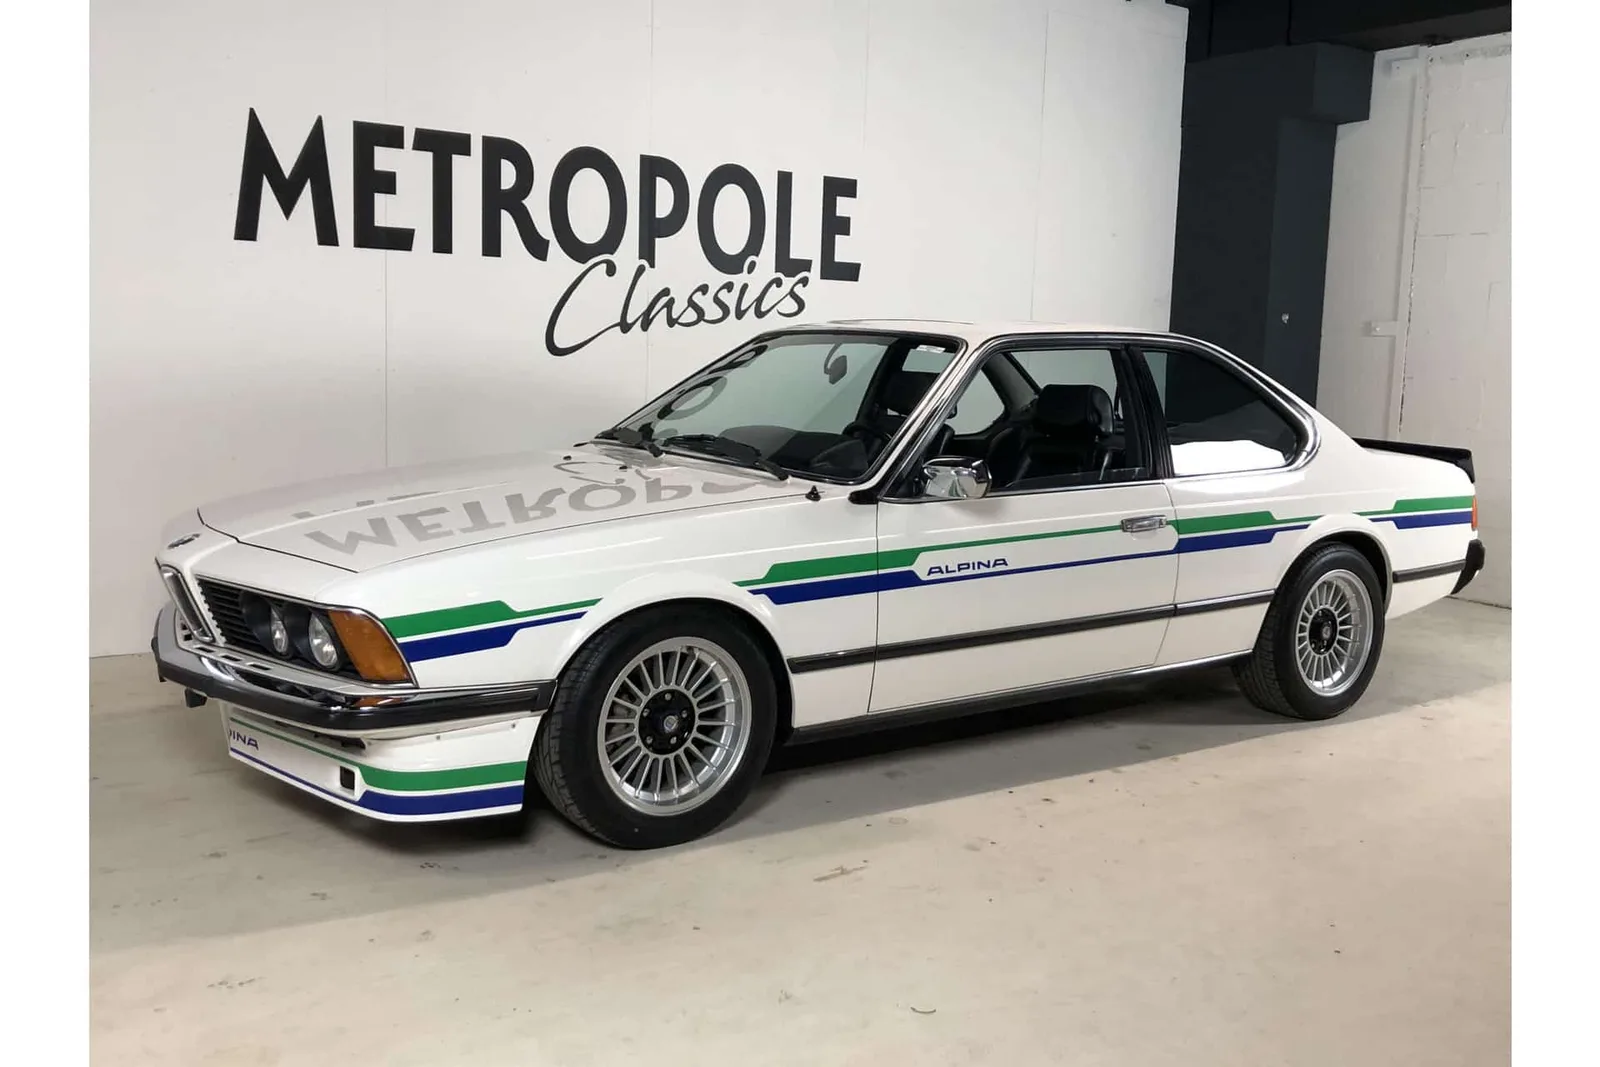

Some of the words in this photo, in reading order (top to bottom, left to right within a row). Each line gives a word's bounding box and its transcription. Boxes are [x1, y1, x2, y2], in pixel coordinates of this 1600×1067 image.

[233, 107, 861, 282] METROPOLE
[545, 257, 810, 357] Classics
[927, 558, 1008, 576] ALPINA
